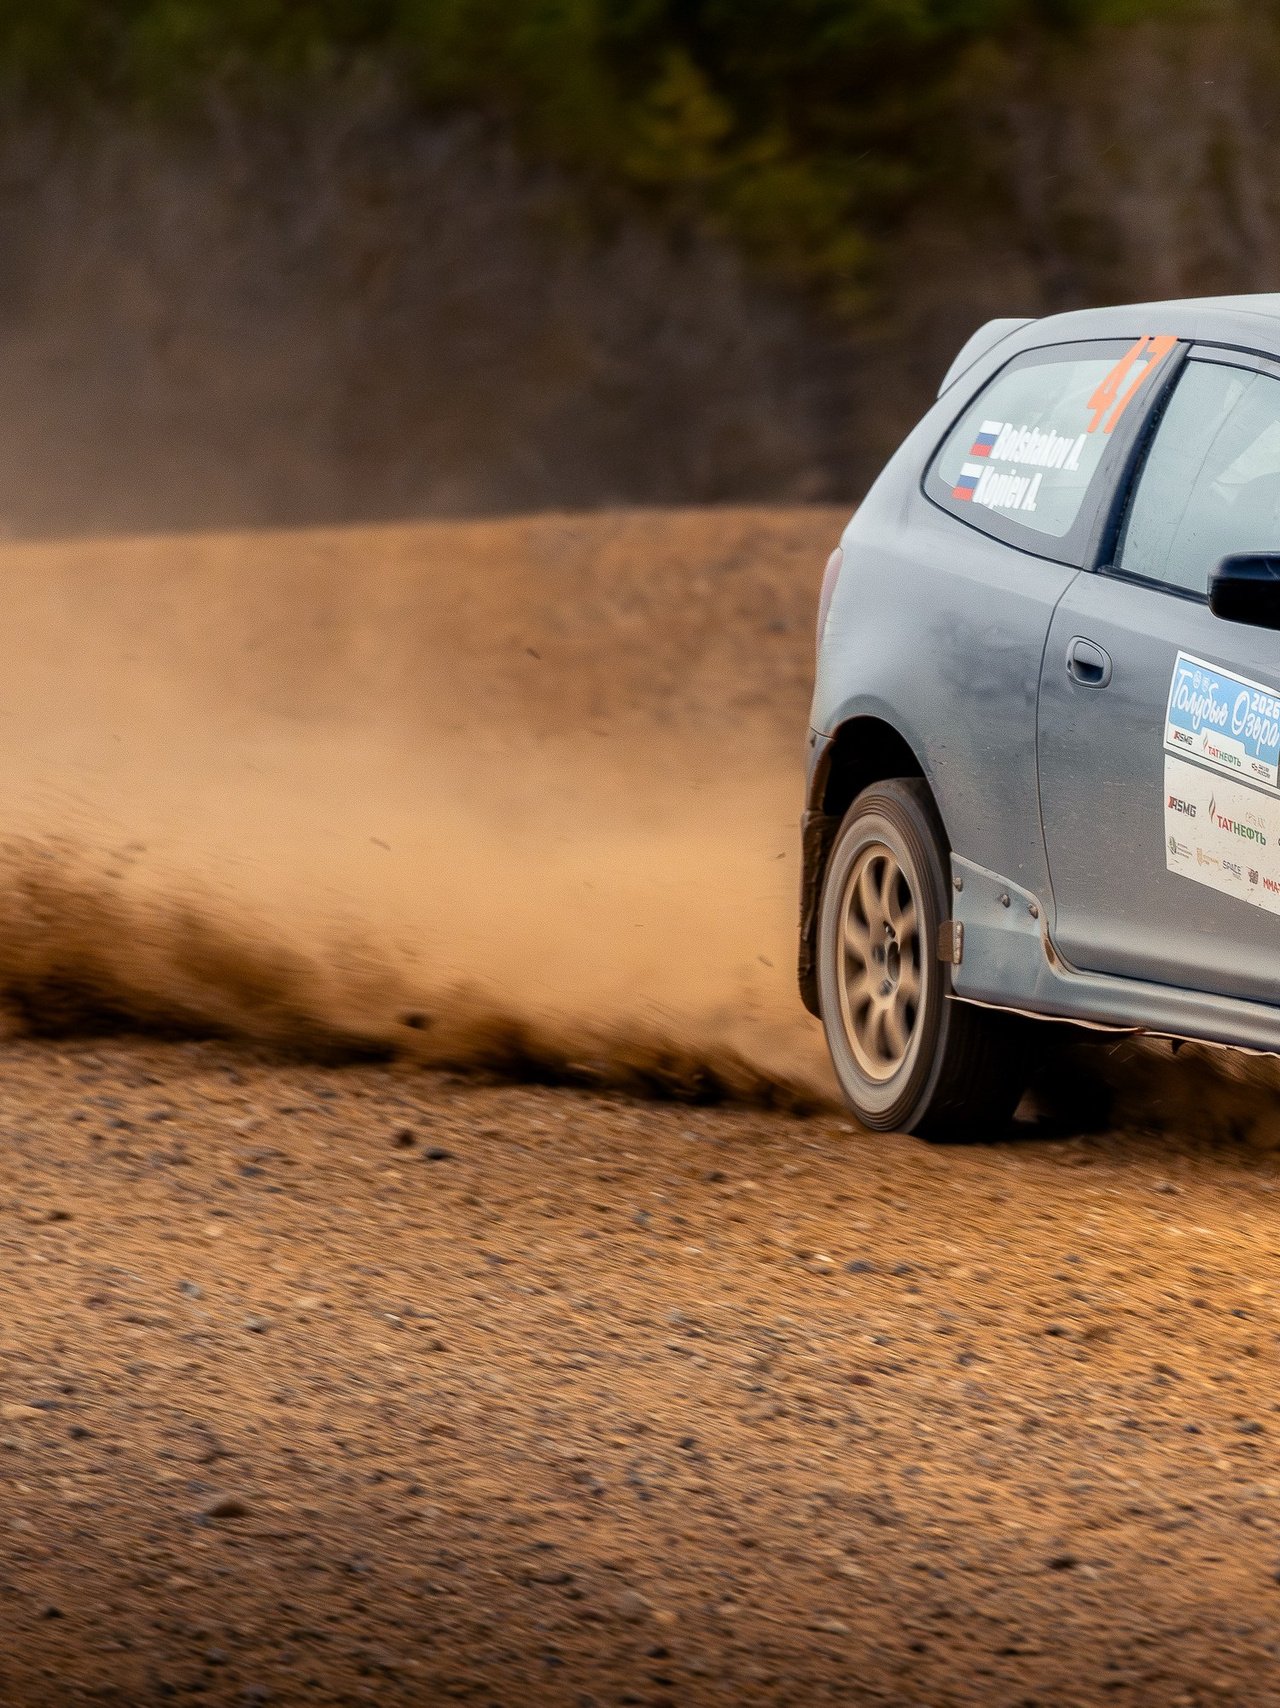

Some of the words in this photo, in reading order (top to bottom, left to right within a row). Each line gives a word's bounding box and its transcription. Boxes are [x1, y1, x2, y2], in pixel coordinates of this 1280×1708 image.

[1087, 335, 1178, 433] 47
[1250, 692, 1280, 718] 2026
[1208, 745, 1242, 767] ТАТНЕФТЬ
[1217, 814, 1267, 846] ТАТНЕФТЬ
